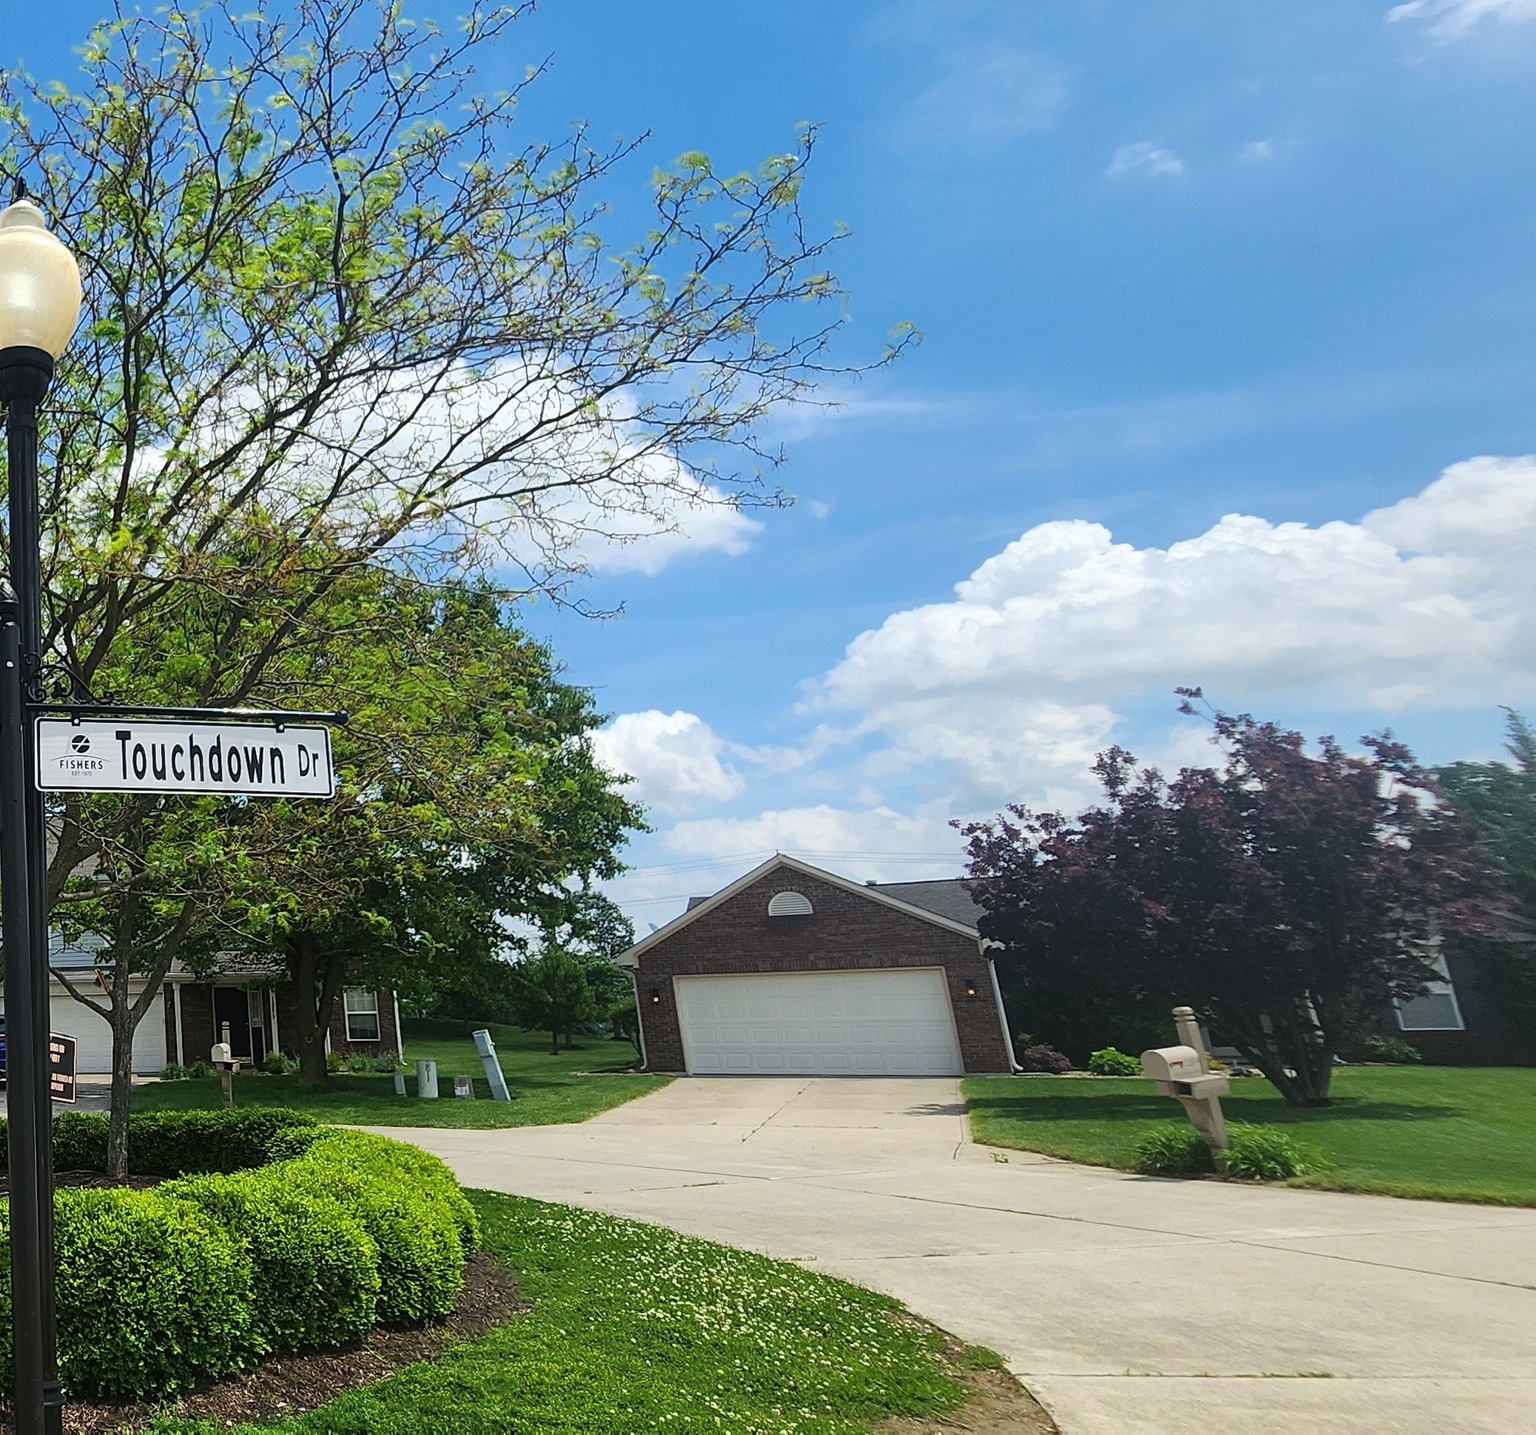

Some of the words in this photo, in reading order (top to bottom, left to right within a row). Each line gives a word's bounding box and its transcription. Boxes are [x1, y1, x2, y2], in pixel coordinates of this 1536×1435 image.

[59, 759, 104, 770] FISHERS
[115, 730, 286, 785] Touchdown
[296, 743, 319, 778] Dr
